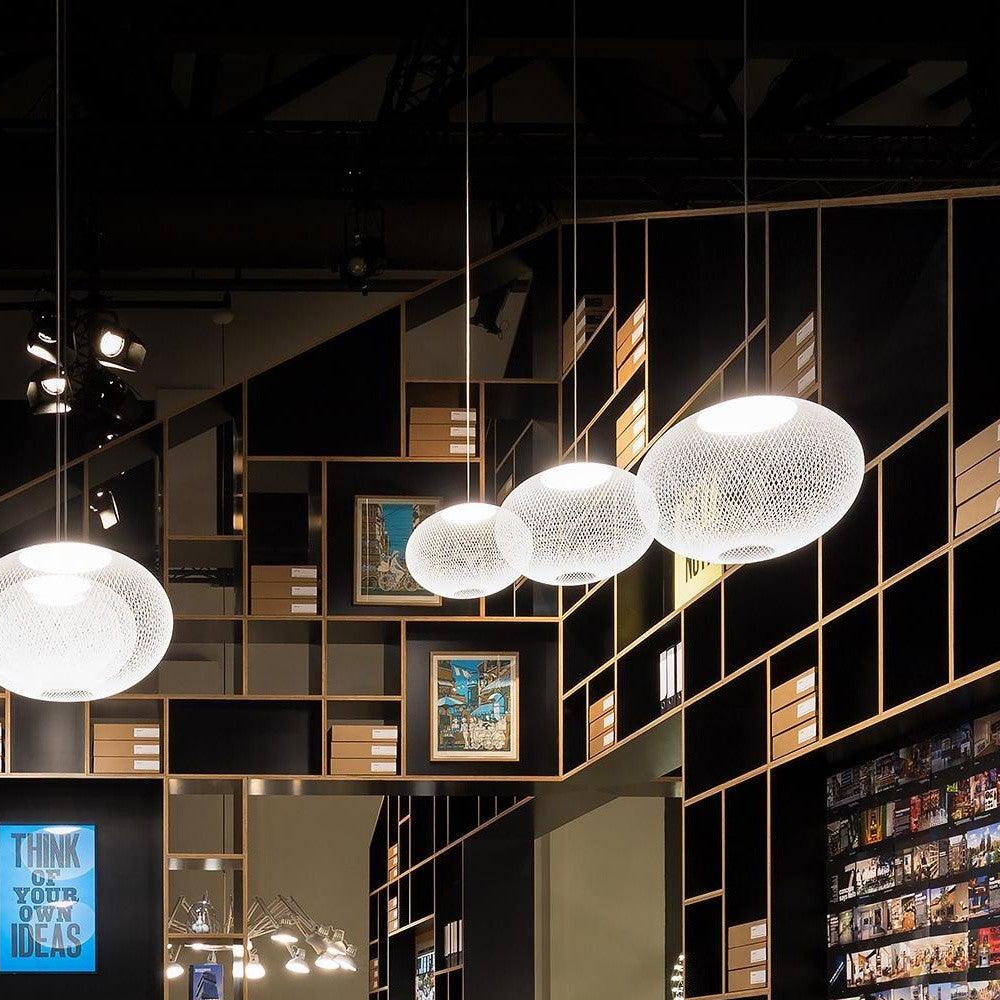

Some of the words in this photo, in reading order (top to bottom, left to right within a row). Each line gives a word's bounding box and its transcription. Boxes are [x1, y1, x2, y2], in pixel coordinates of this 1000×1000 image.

[10, 832, 81, 869] THINK
[31, 869, 61, 887] OF
[13, 887, 80, 905] YOUR
[19, 904, 74, 923] OWN
[10, 923, 82, 959] IDEAS
